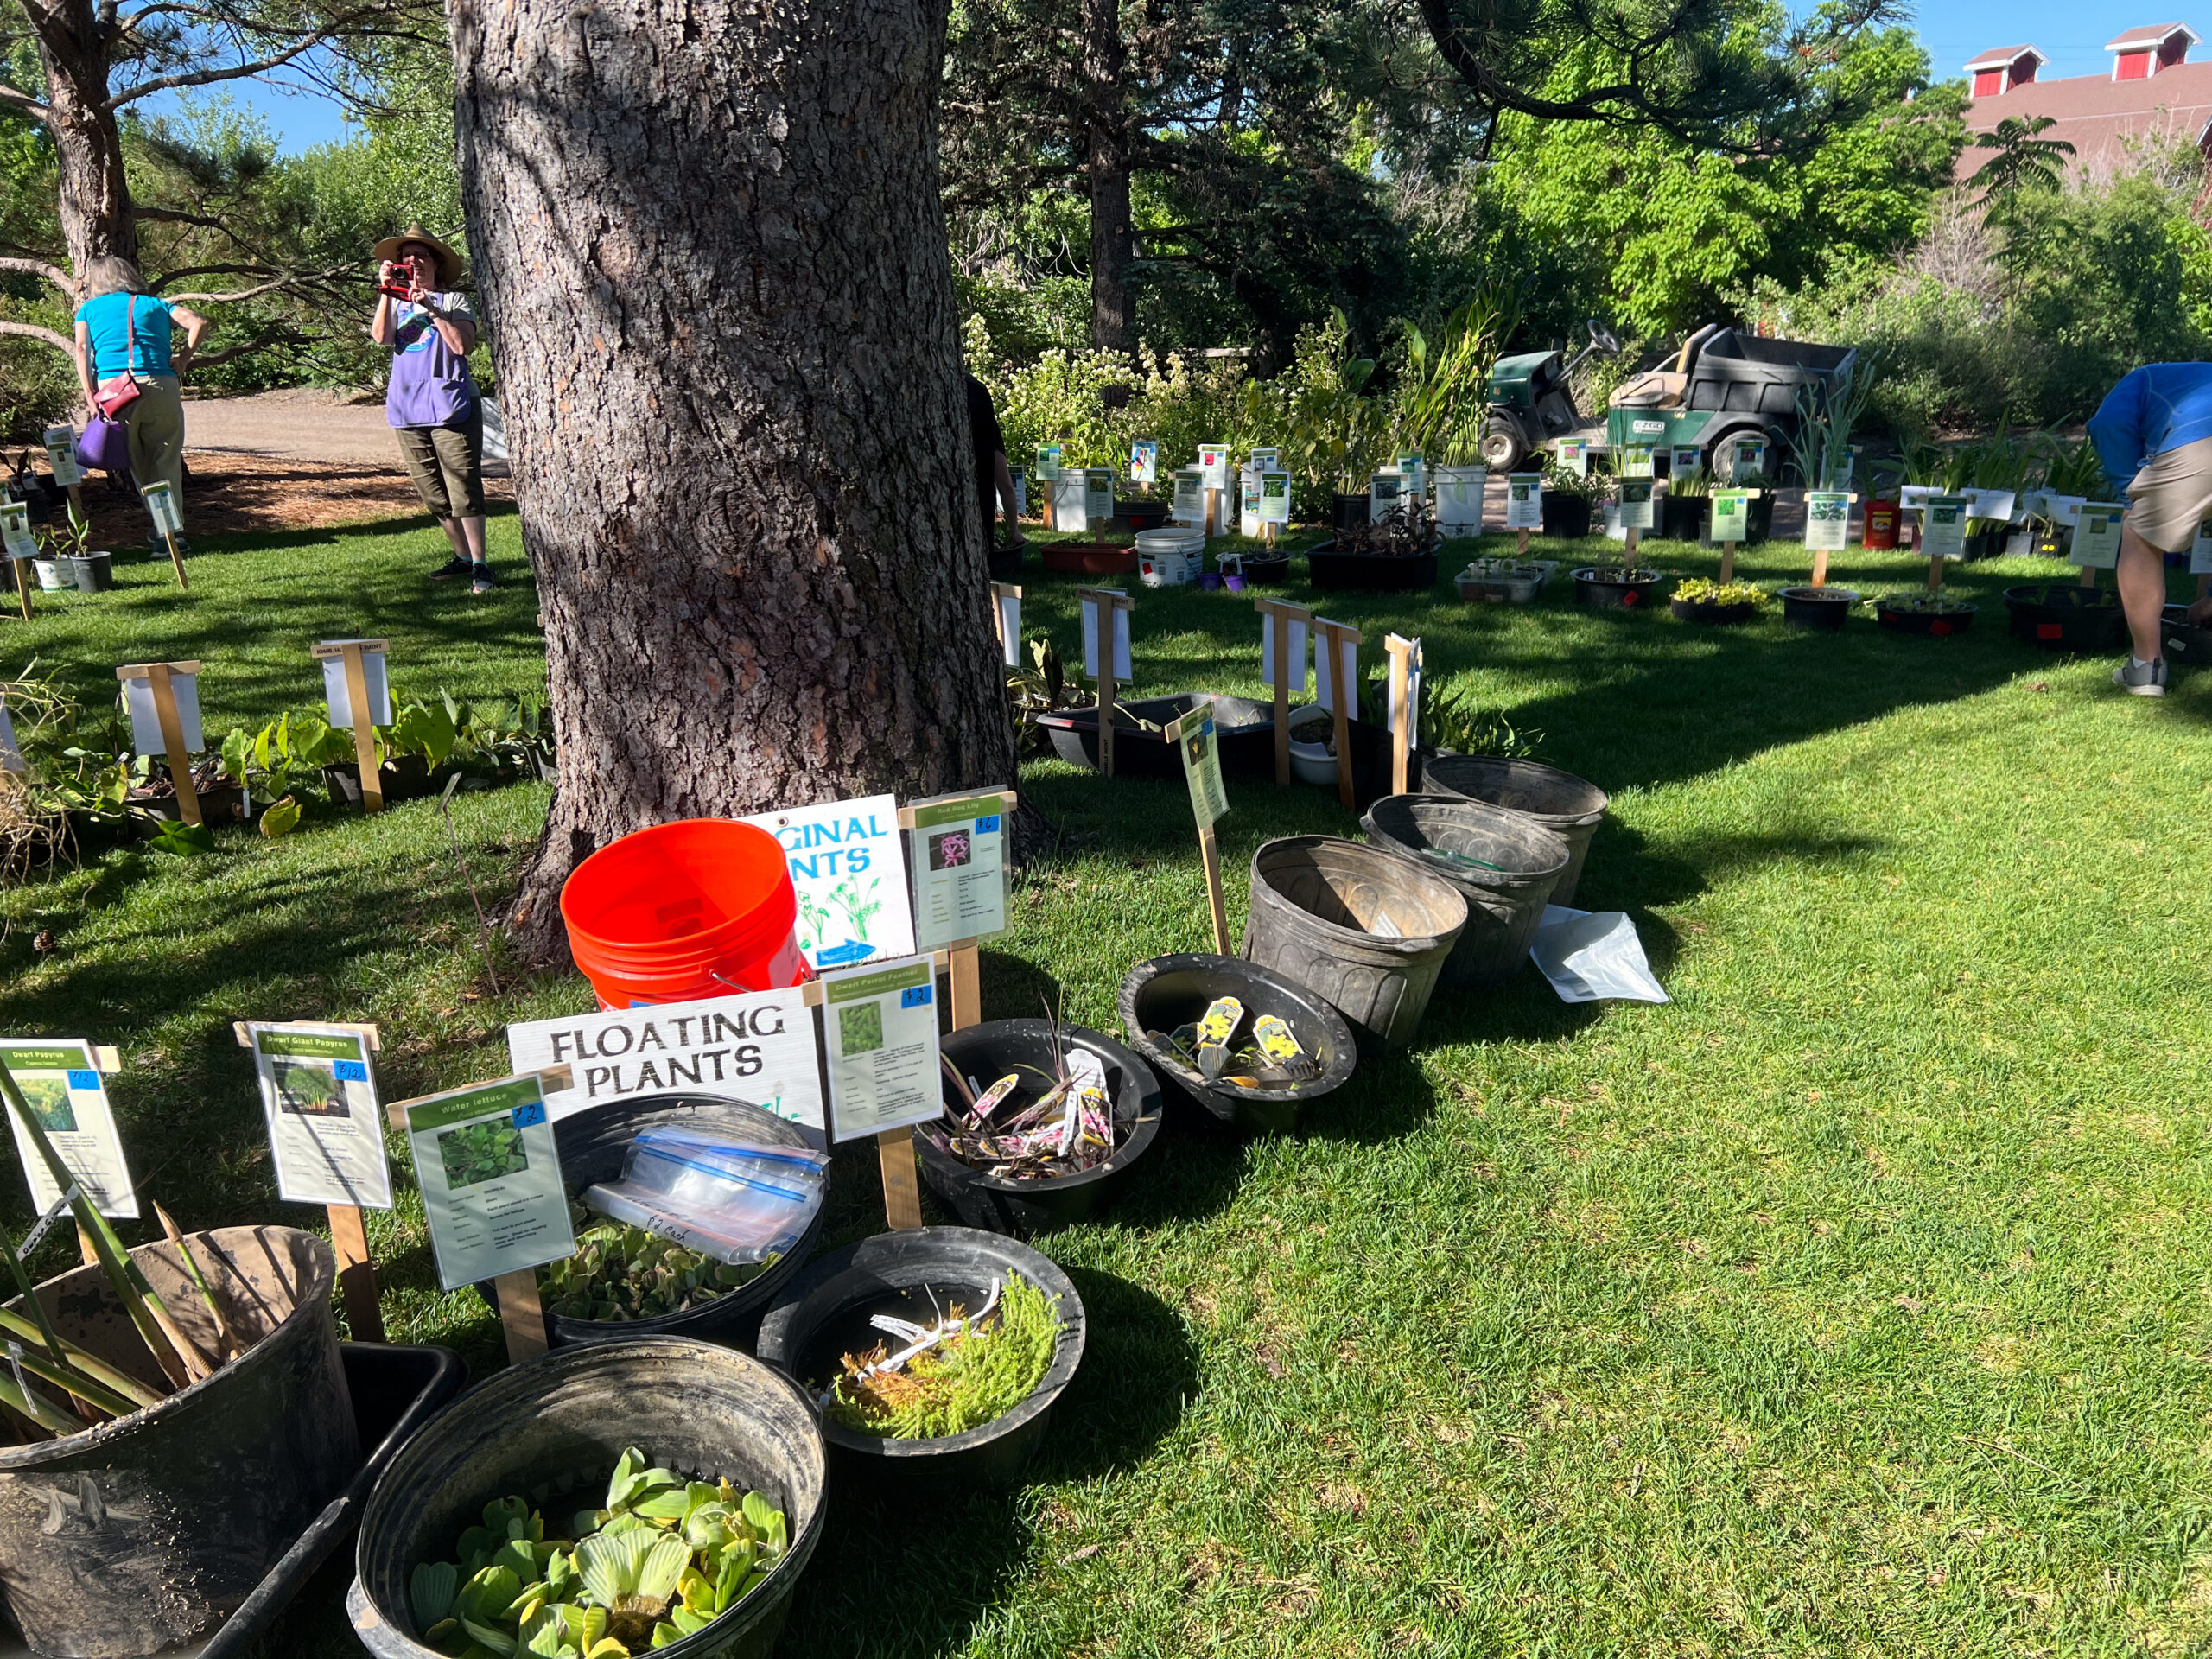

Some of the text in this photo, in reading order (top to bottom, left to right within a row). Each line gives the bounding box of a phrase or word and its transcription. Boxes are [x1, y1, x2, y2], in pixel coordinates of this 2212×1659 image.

[836, 981, 859, 991] Dwarf
[267, 1035, 289, 1044] Dwarf
[315, 1039, 347, 1048] Papyrus
[550, 1005, 786, 1063] FLOATING
[35, 1051, 65, 1059] Papyrus
[584, 1045, 764, 1097] PLANTS
[441, 1101, 470, 1114] Water
[473, 1092, 508, 1106] lettuce
[664, 1224, 691, 1243] each
